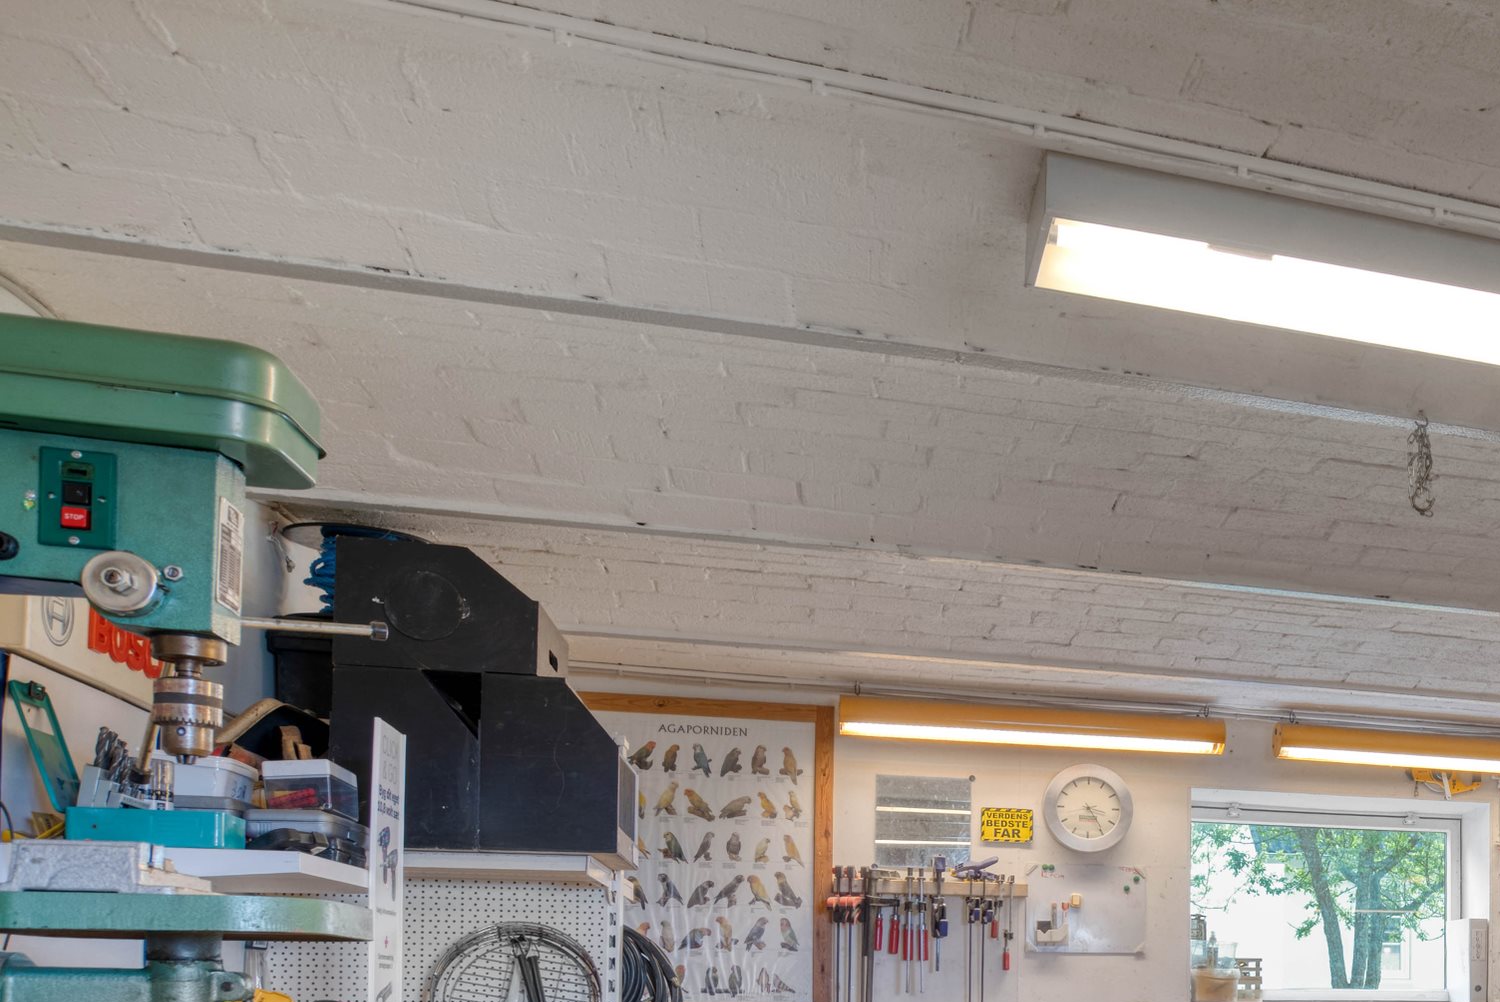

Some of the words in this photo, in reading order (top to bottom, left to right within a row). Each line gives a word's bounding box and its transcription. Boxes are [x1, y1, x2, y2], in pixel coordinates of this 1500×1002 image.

[88, 606, 164, 679] BOSC
[658, 723, 748, 737] AGAPORNIDEN
[986, 812, 1029, 820] VERDENS
[986, 819, 1029, 829] BEDSTE
[993, 828, 1021, 839] FAR
